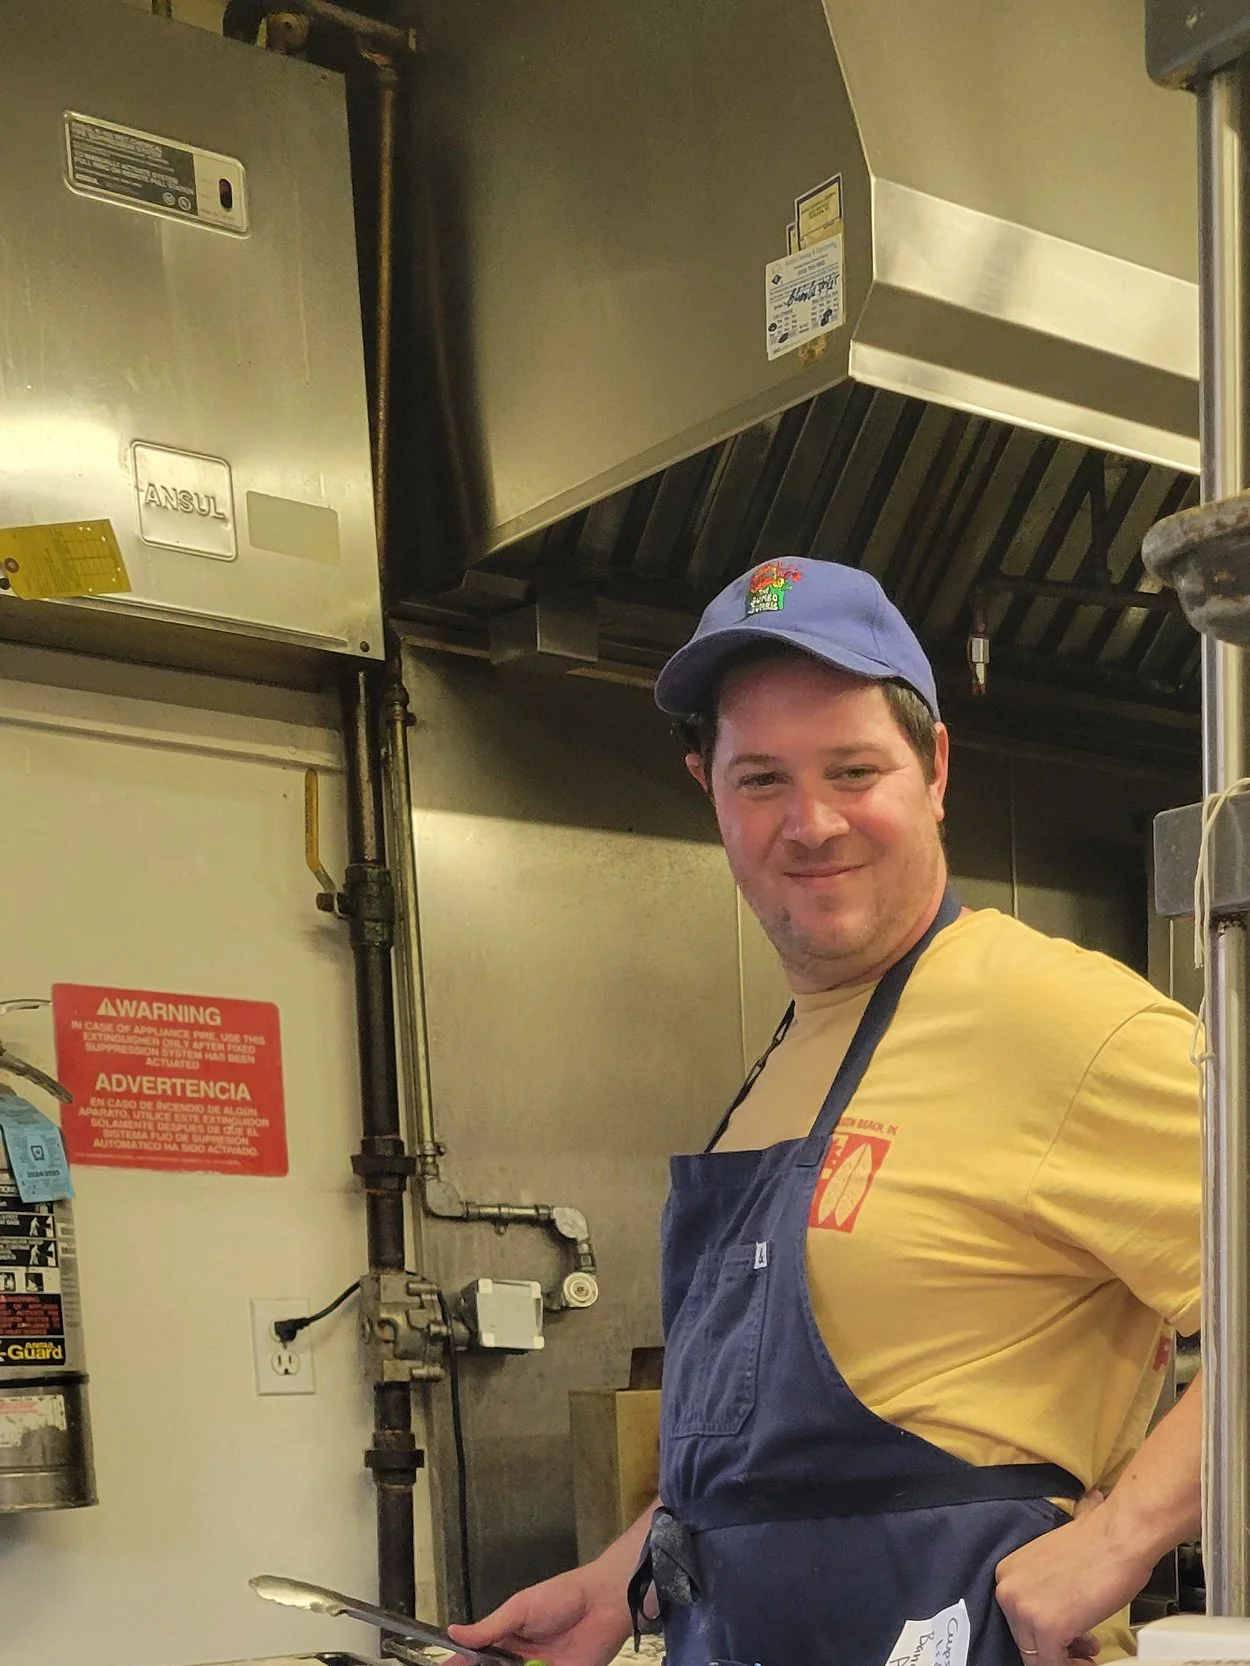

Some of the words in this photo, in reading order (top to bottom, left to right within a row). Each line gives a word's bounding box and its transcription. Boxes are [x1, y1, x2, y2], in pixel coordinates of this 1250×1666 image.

[144, 483, 226, 520] ANSUL
[116, 998, 221, 1026] WARNING
[83, 1031, 160, 1047] EXTINGUISHER
[163, 1038, 190, 1049] ONLY
[192, 1041, 225, 1052] AFTER
[85, 1021, 114, 1033] CASE
[117, 1024, 131, 1034] OF
[133, 1026, 191, 1040] APPLIANCE
[220, 1033, 240, 1043] USE
[85, 1042, 159, 1058] SUPPRESSION
[162, 1048, 202, 1060] SYSTEM
[205, 1052, 226, 1063] HAS
[145, 1057, 200, 1070] ACTUATED
[95, 1073, 251, 1101] ADVERTENCIA
[0, 1342, 63, 1361] -Guard
